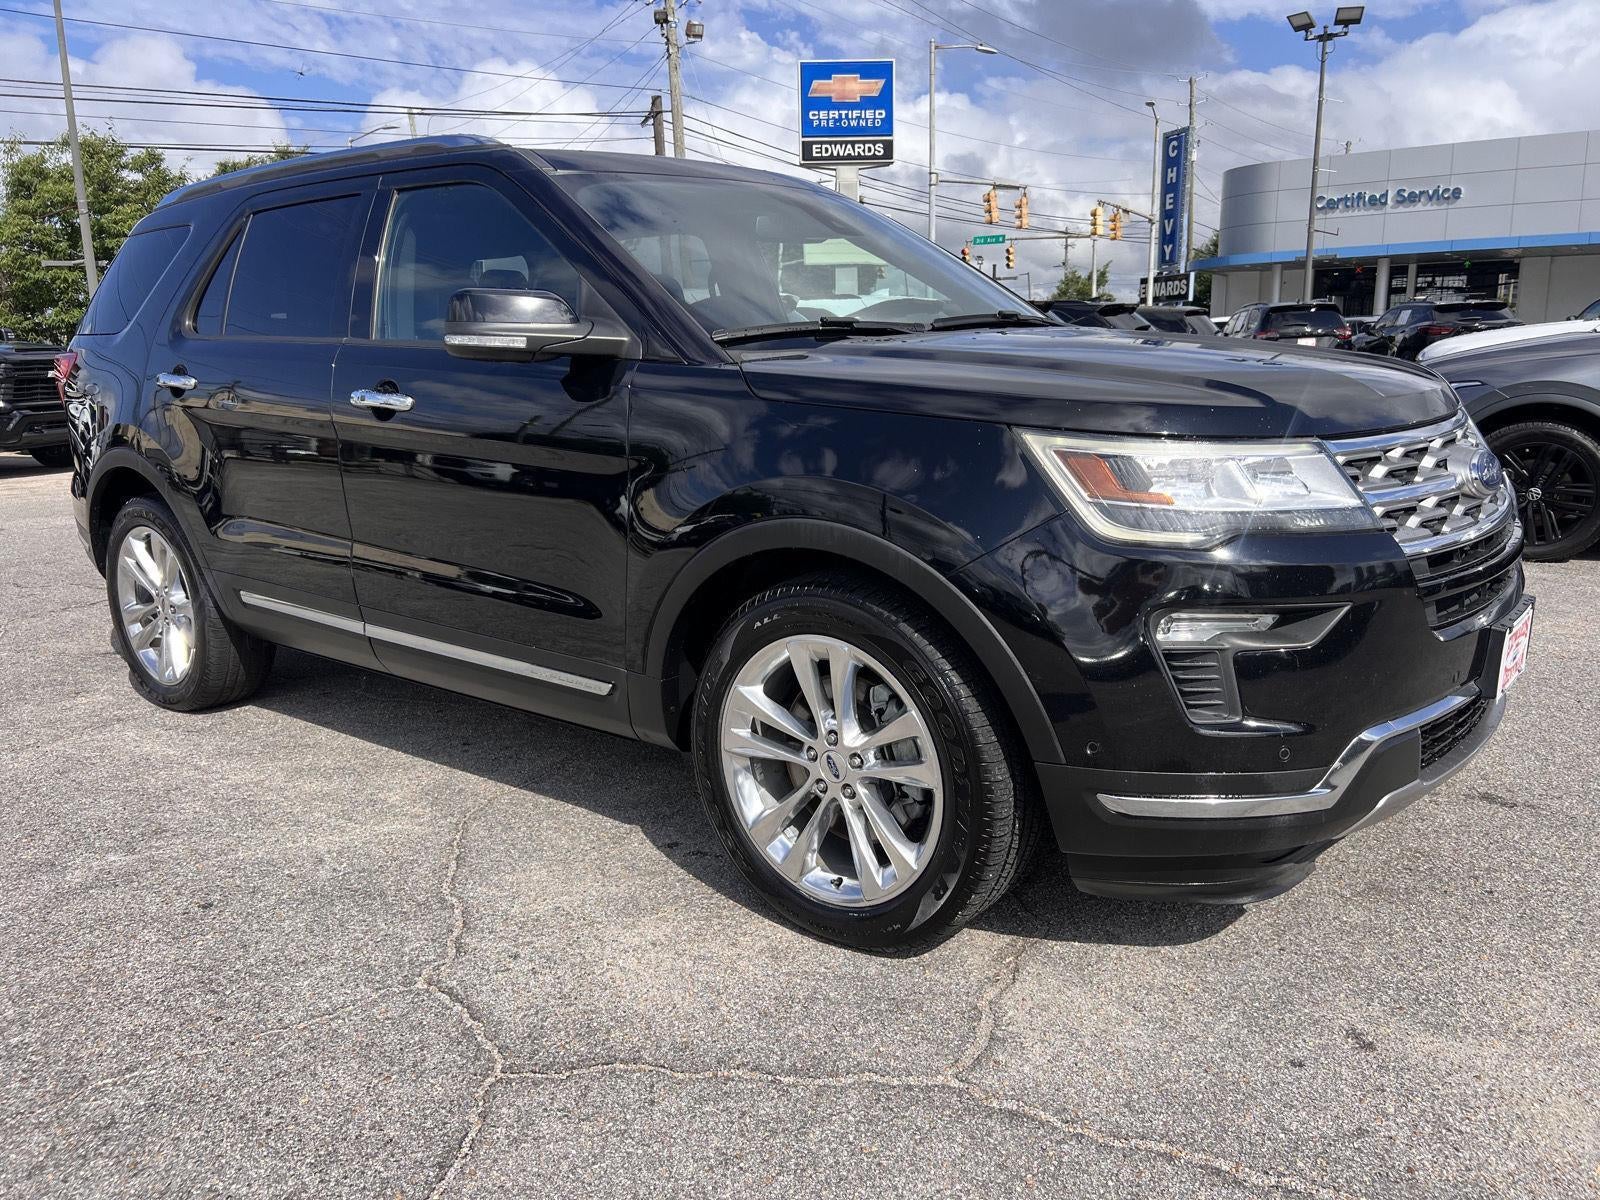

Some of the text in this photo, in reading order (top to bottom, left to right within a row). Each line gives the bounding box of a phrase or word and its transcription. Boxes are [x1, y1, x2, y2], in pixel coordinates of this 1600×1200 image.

[808, 109, 886, 120] CERTIFIED
[813, 119, 882, 128] PRE-OWNED
[812, 143, 885, 157] EDWARDS
[1163, 140, 1178, 260] CHEVY
[1315, 185, 1463, 210] Certified Service
[1140, 279, 1188, 298] EWARDS
